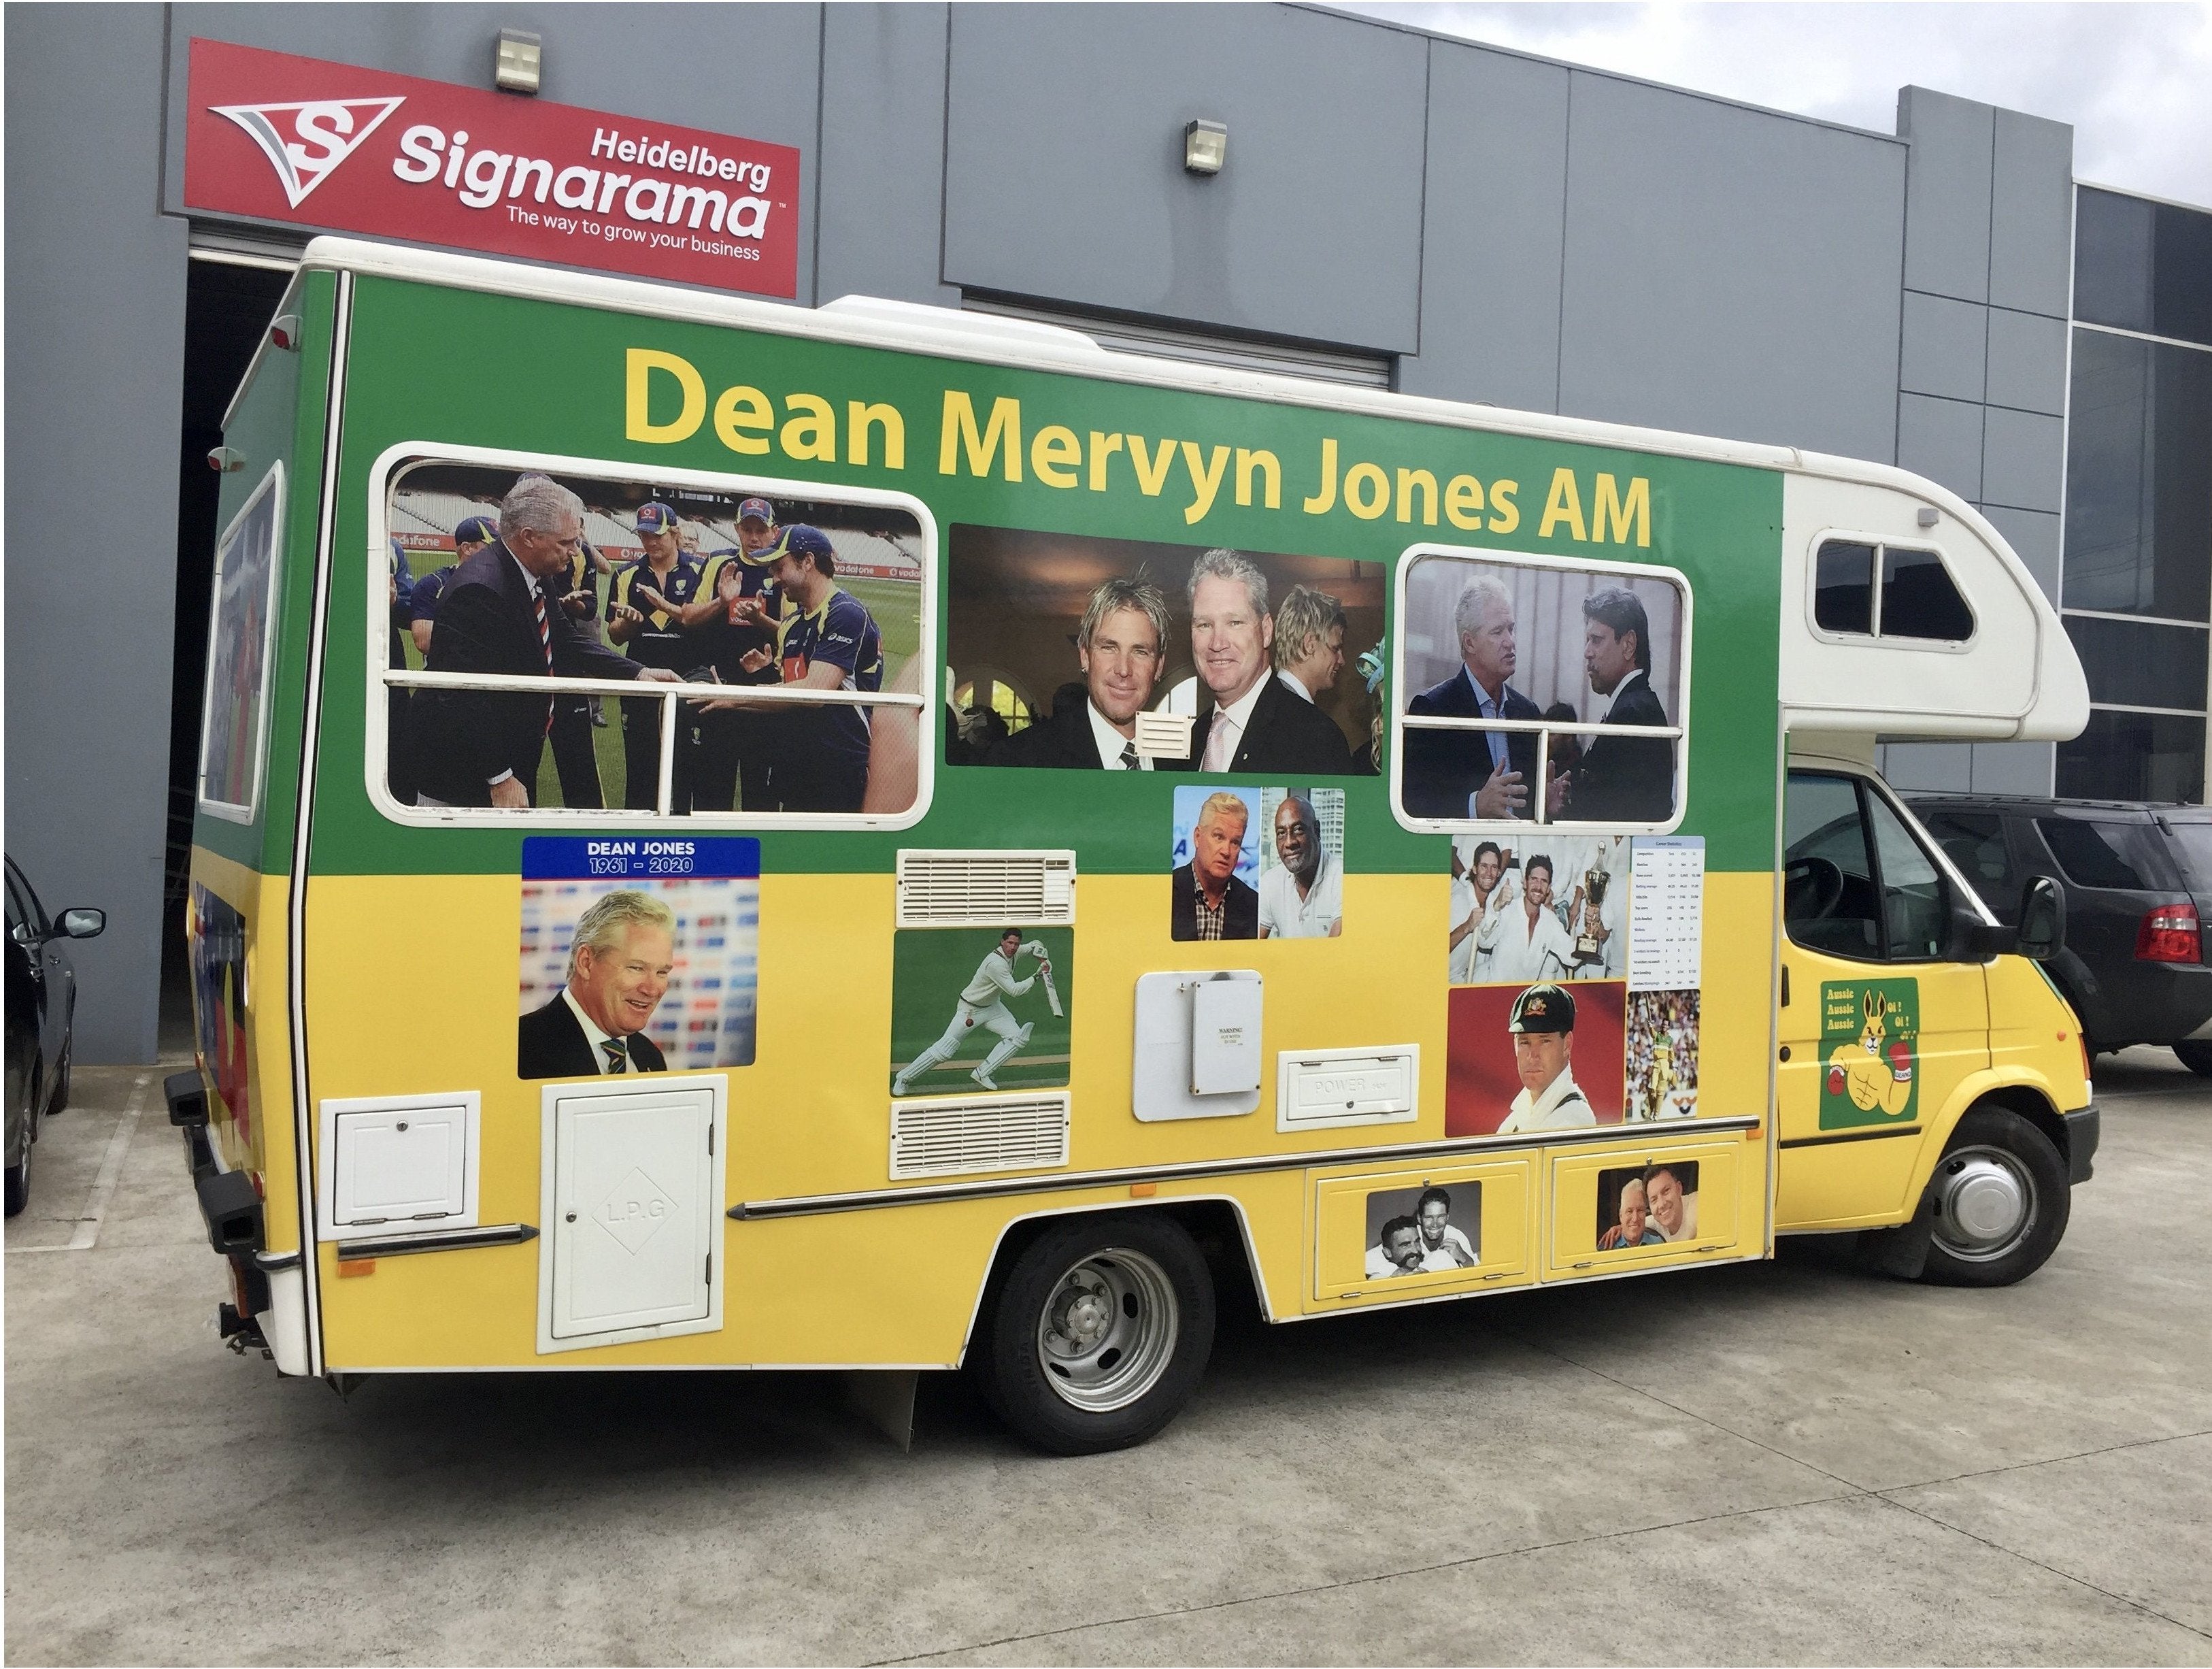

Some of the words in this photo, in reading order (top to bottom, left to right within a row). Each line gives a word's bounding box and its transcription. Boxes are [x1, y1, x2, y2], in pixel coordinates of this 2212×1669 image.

[590, 127, 771, 193] Heidelberg
[392, 125, 771, 240] Signarama
[506, 205, 539, 226] The
[543, 215, 578, 235] way
[582, 219, 601, 235] to
[604, 225, 647, 242] grow
[650, 232, 688, 248] your
[691, 235, 760, 261] business
[625, 348, 905, 469] Dean
[939, 389, 1281, 525] Mervyn
[1303, 438, 1520, 534] Jones
[1538, 467, 1651, 547] AM
[588, 842, 636, 856] DEAN
[641, 842, 695, 856] JONES
[589, 857, 628, 874] 1961
[648, 857, 694, 874] 2020
[1826, 988, 1854, 1000] Aussie
[1827, 1003, 1855, 1015] Aussie
[1827, 1018, 1854, 1030] Aussie
[1315, 1078, 1365, 1093] POWER
